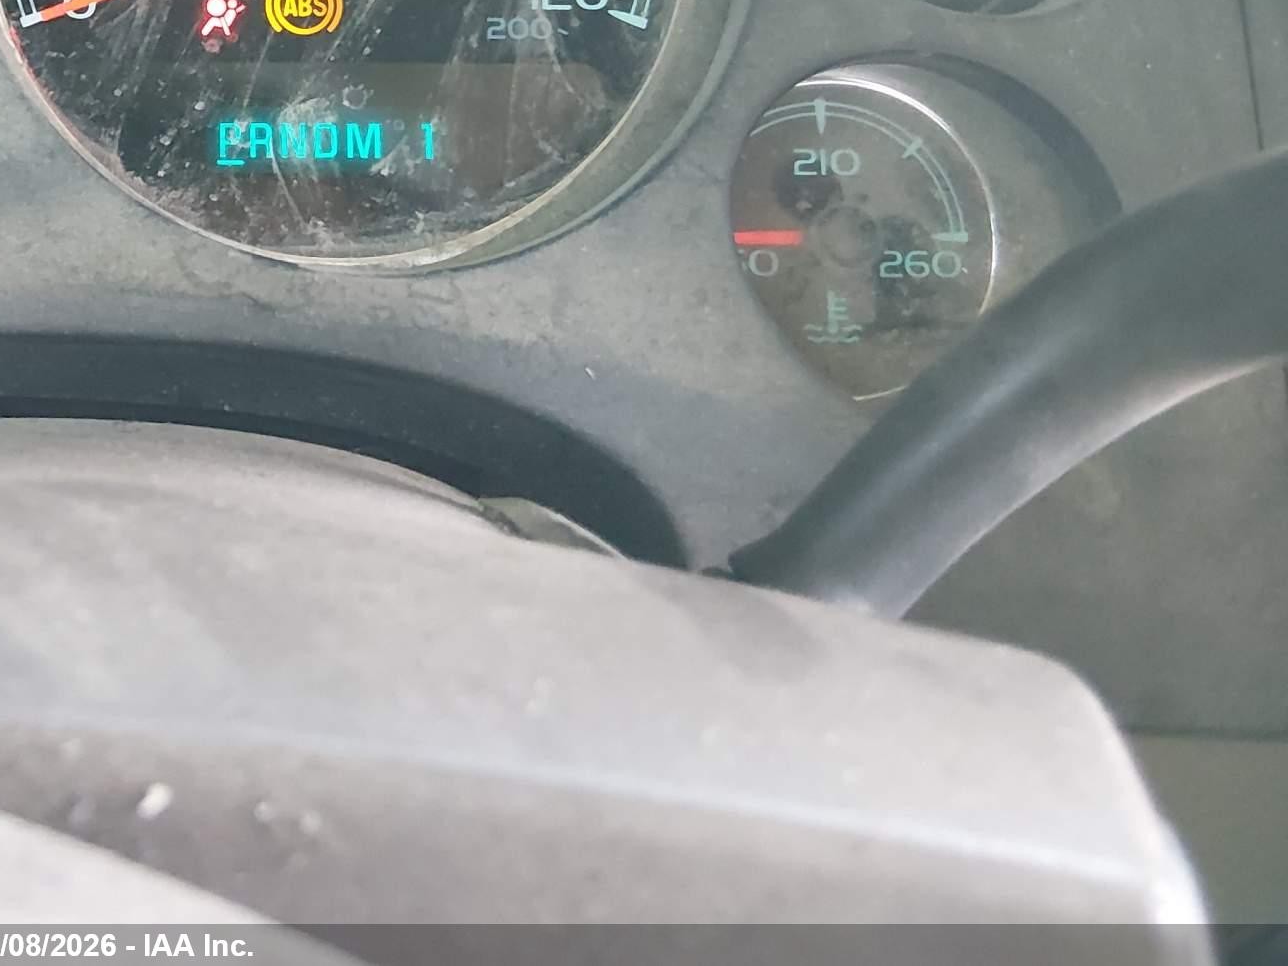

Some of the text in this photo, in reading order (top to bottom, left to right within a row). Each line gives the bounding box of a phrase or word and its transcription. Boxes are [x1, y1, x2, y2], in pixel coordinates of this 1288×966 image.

[486, 17, 553, 41] 200
[216, 122, 383, 165] PRNDM
[792, 148, 861, 177] 210
[879, 250, 962, 278] 260
